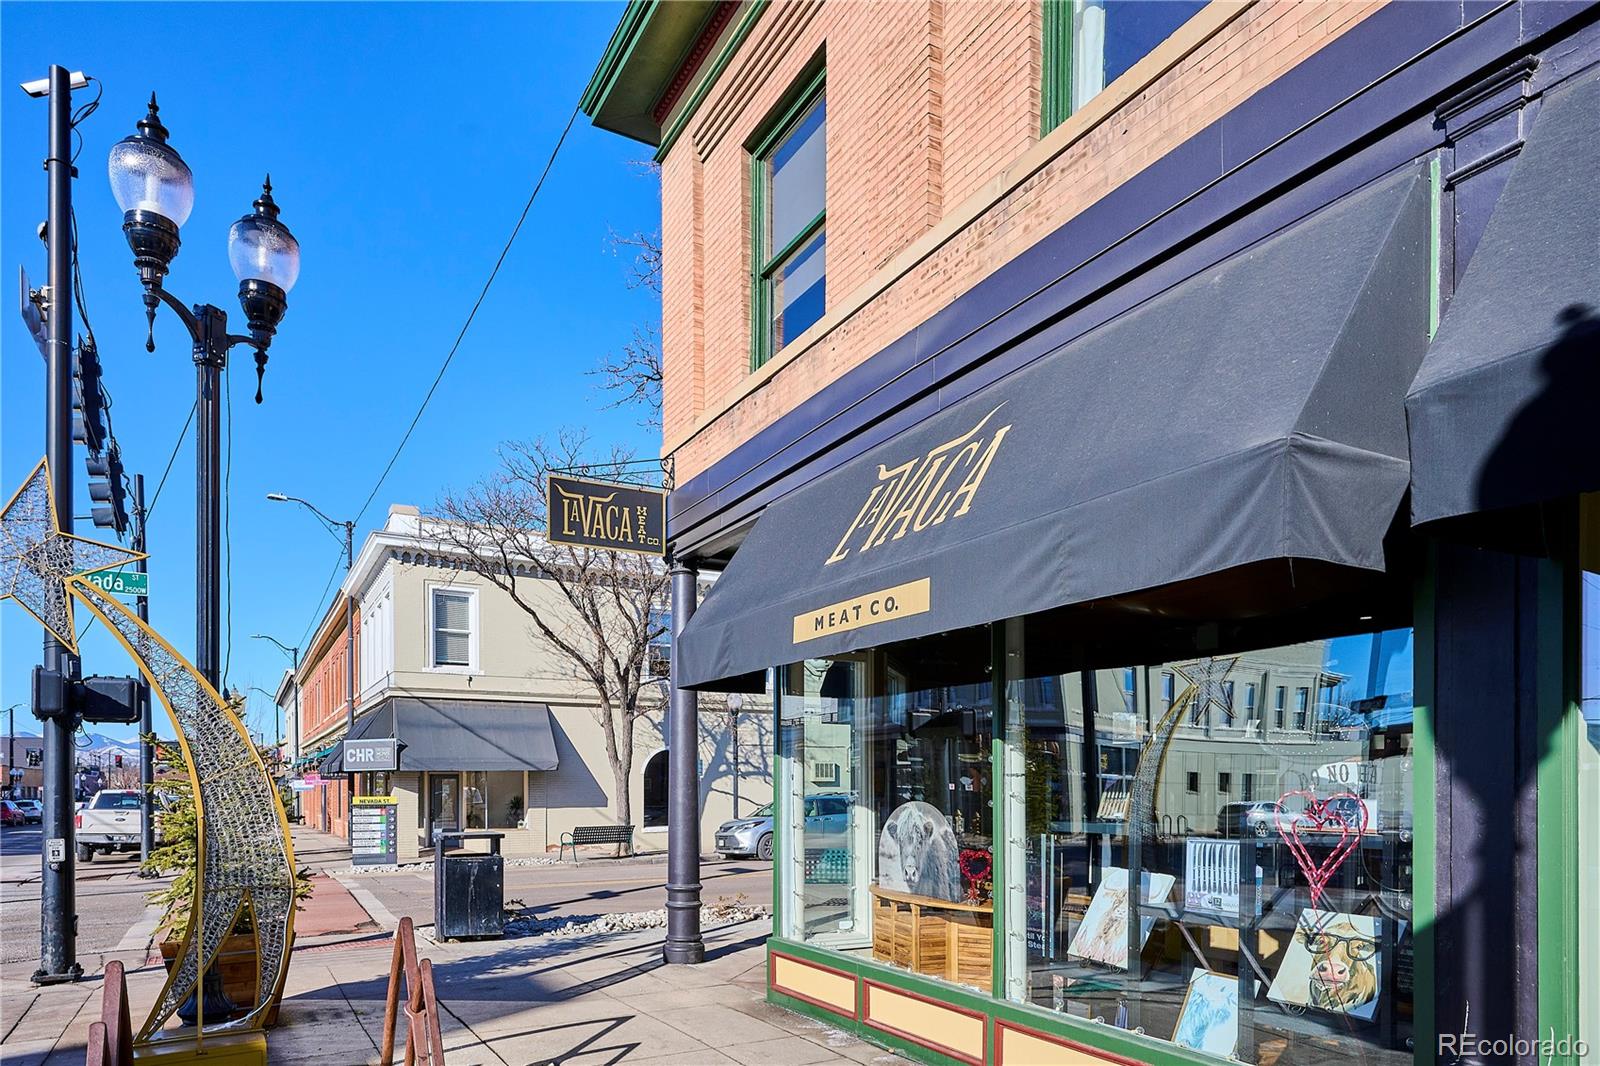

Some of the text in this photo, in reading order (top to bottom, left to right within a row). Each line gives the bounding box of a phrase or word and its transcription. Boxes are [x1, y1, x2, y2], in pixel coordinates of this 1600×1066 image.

[636, 505, 648, 544] MEAT
[83, 574, 124, 591] vada
[124, 586, 147, 594] 2500W
[814, 596, 899, 631] MEAT CO.
[346, 748, 374, 763] CHR
